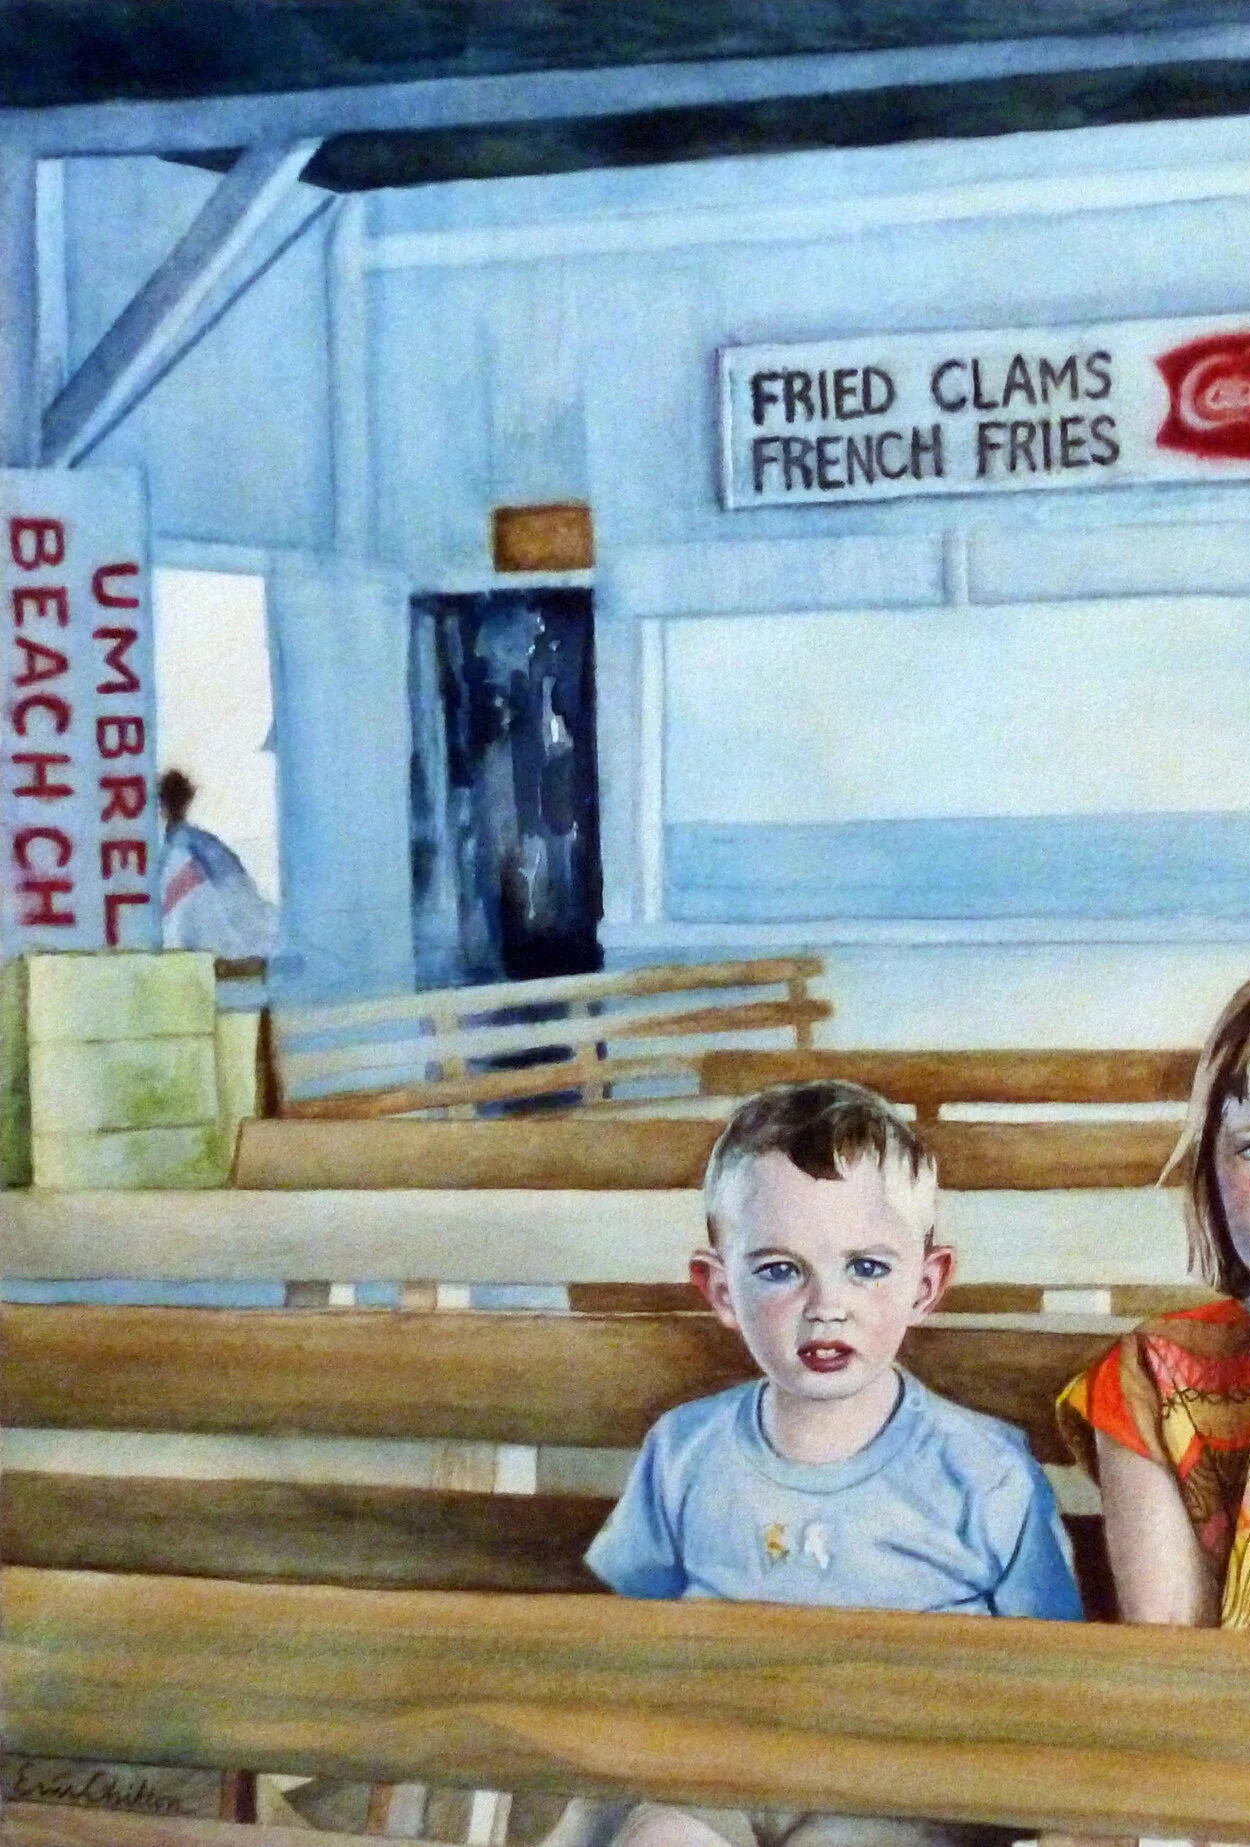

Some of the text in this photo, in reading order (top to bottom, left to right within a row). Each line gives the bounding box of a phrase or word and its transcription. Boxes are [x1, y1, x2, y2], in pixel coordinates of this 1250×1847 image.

[750, 351, 1111, 425] FRIED CLAMS
[752, 415, 1120, 493] FRENCH FRIES
[10, 518, 75, 926] BEACH CH
[91, 563, 151, 946] UMBREL
